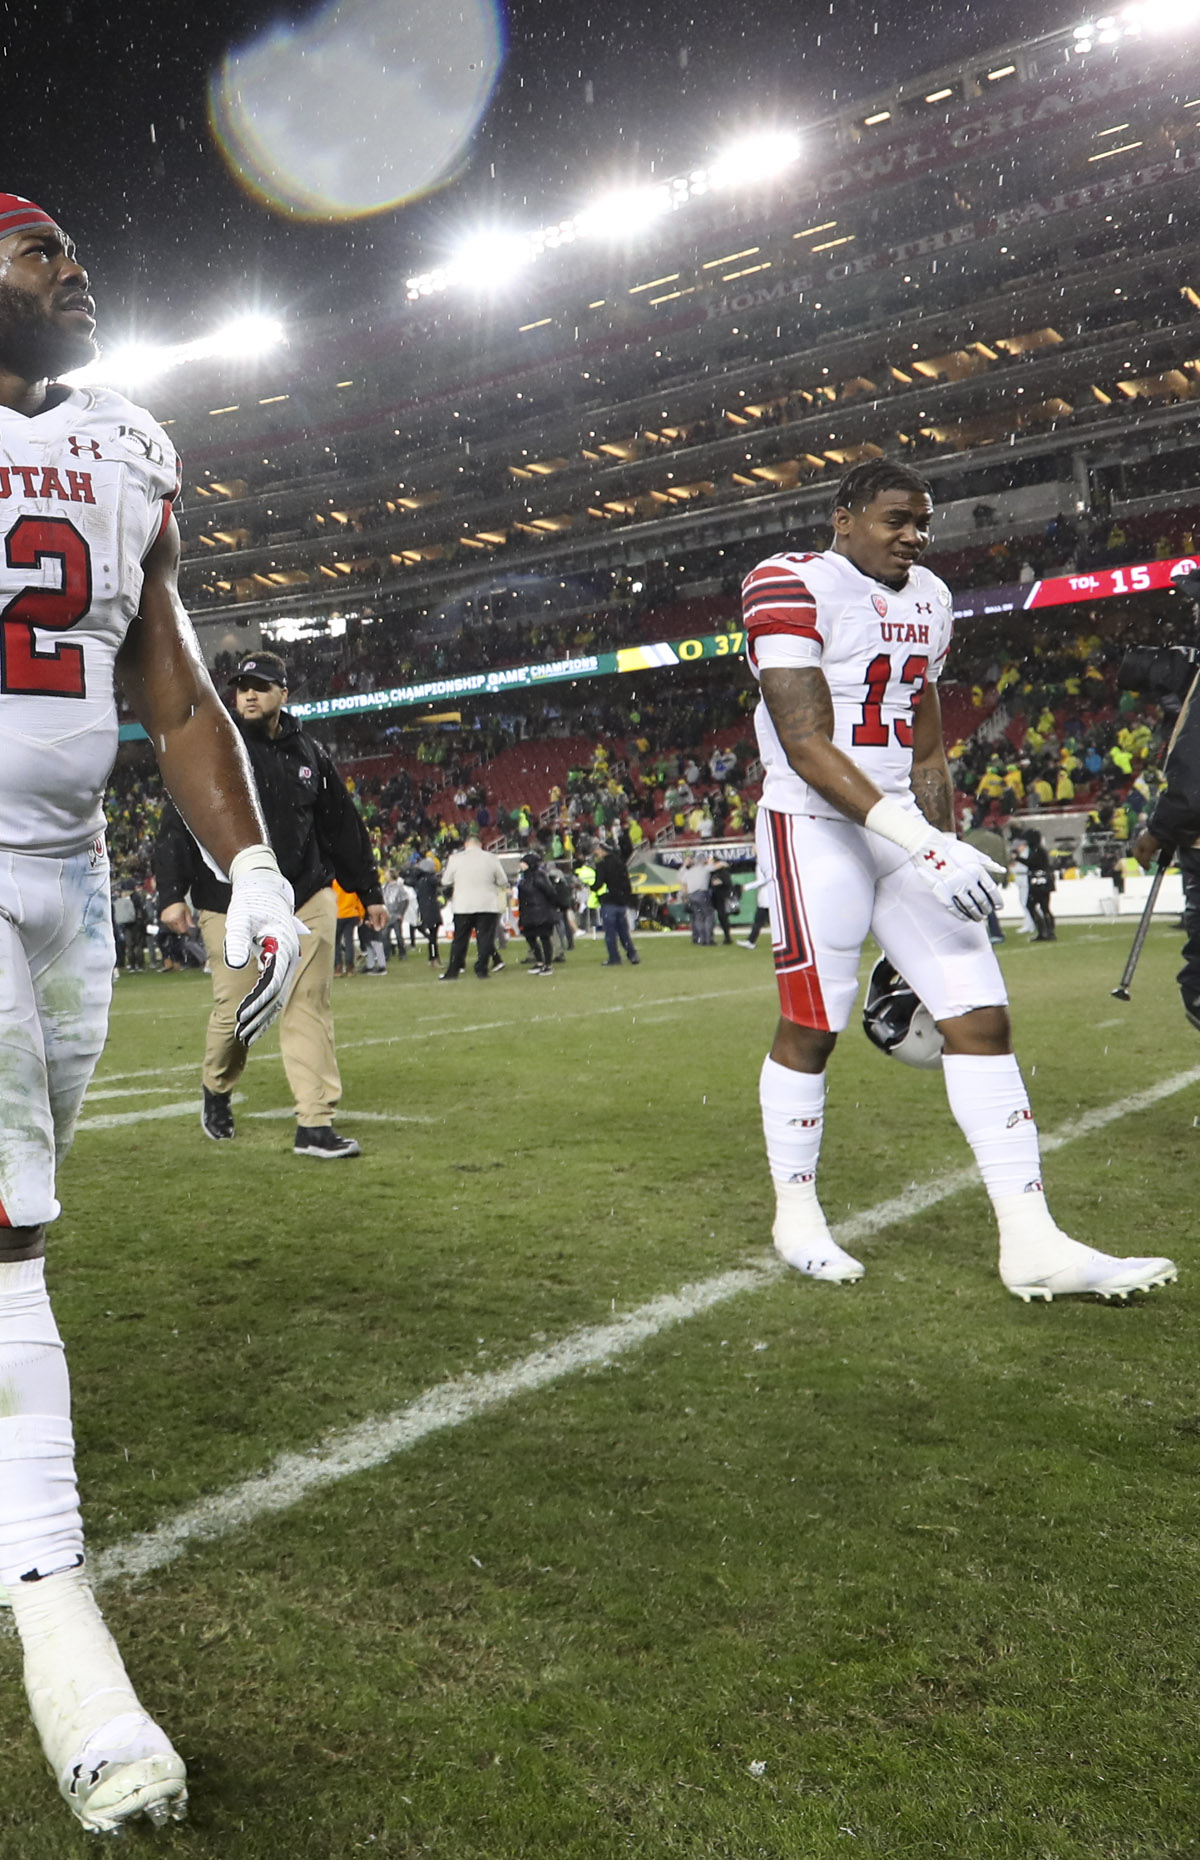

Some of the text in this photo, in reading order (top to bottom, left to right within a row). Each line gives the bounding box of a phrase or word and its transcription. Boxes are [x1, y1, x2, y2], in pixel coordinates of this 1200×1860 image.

[705, 273, 813, 321] HOME
[826, 252, 877, 282] OF
[897, 223, 973, 262] THE
[1069, 574, 1100, 591] TOL
[1111, 566, 1150, 594] 15
[714, 633, 743, 656] 37
[880, 622, 930, 645] UTAH
[291, 656, 598, 717] PAC-12 FOOTBALL CHAMPIONSHIP GAME CHAMPIONS
[851, 653, 929, 747] 13
